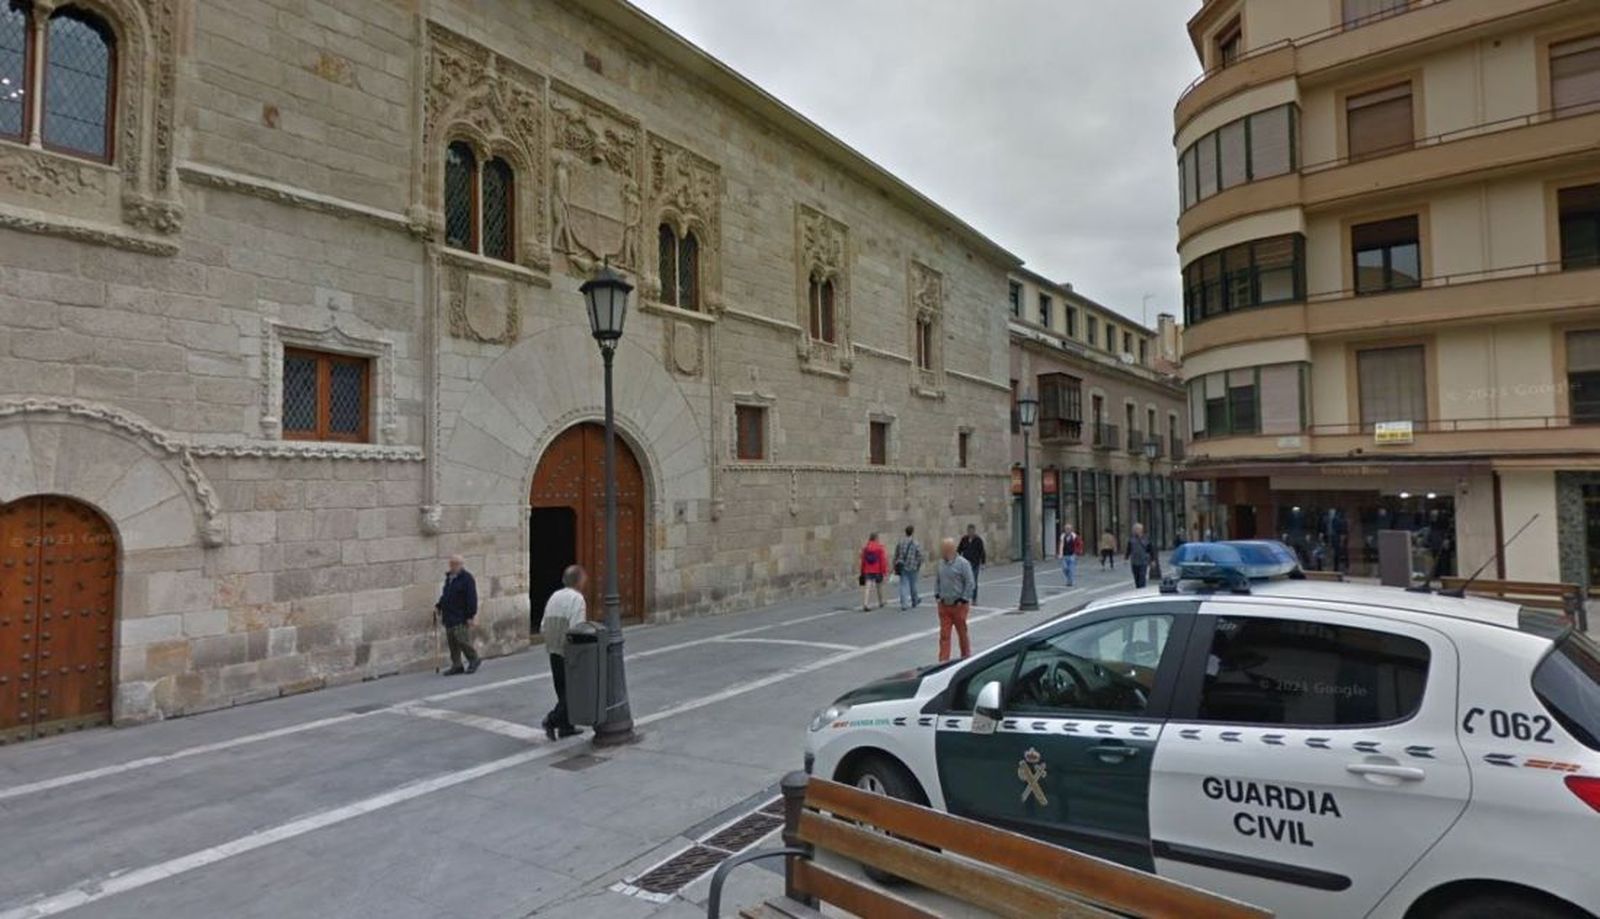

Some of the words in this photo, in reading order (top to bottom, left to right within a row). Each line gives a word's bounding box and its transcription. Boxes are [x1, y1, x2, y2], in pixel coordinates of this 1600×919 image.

[1489, 709, 1555, 744] 062
[1202, 776, 1341, 818] GUARDIA
[1233, 812, 1314, 847] CIVIL
